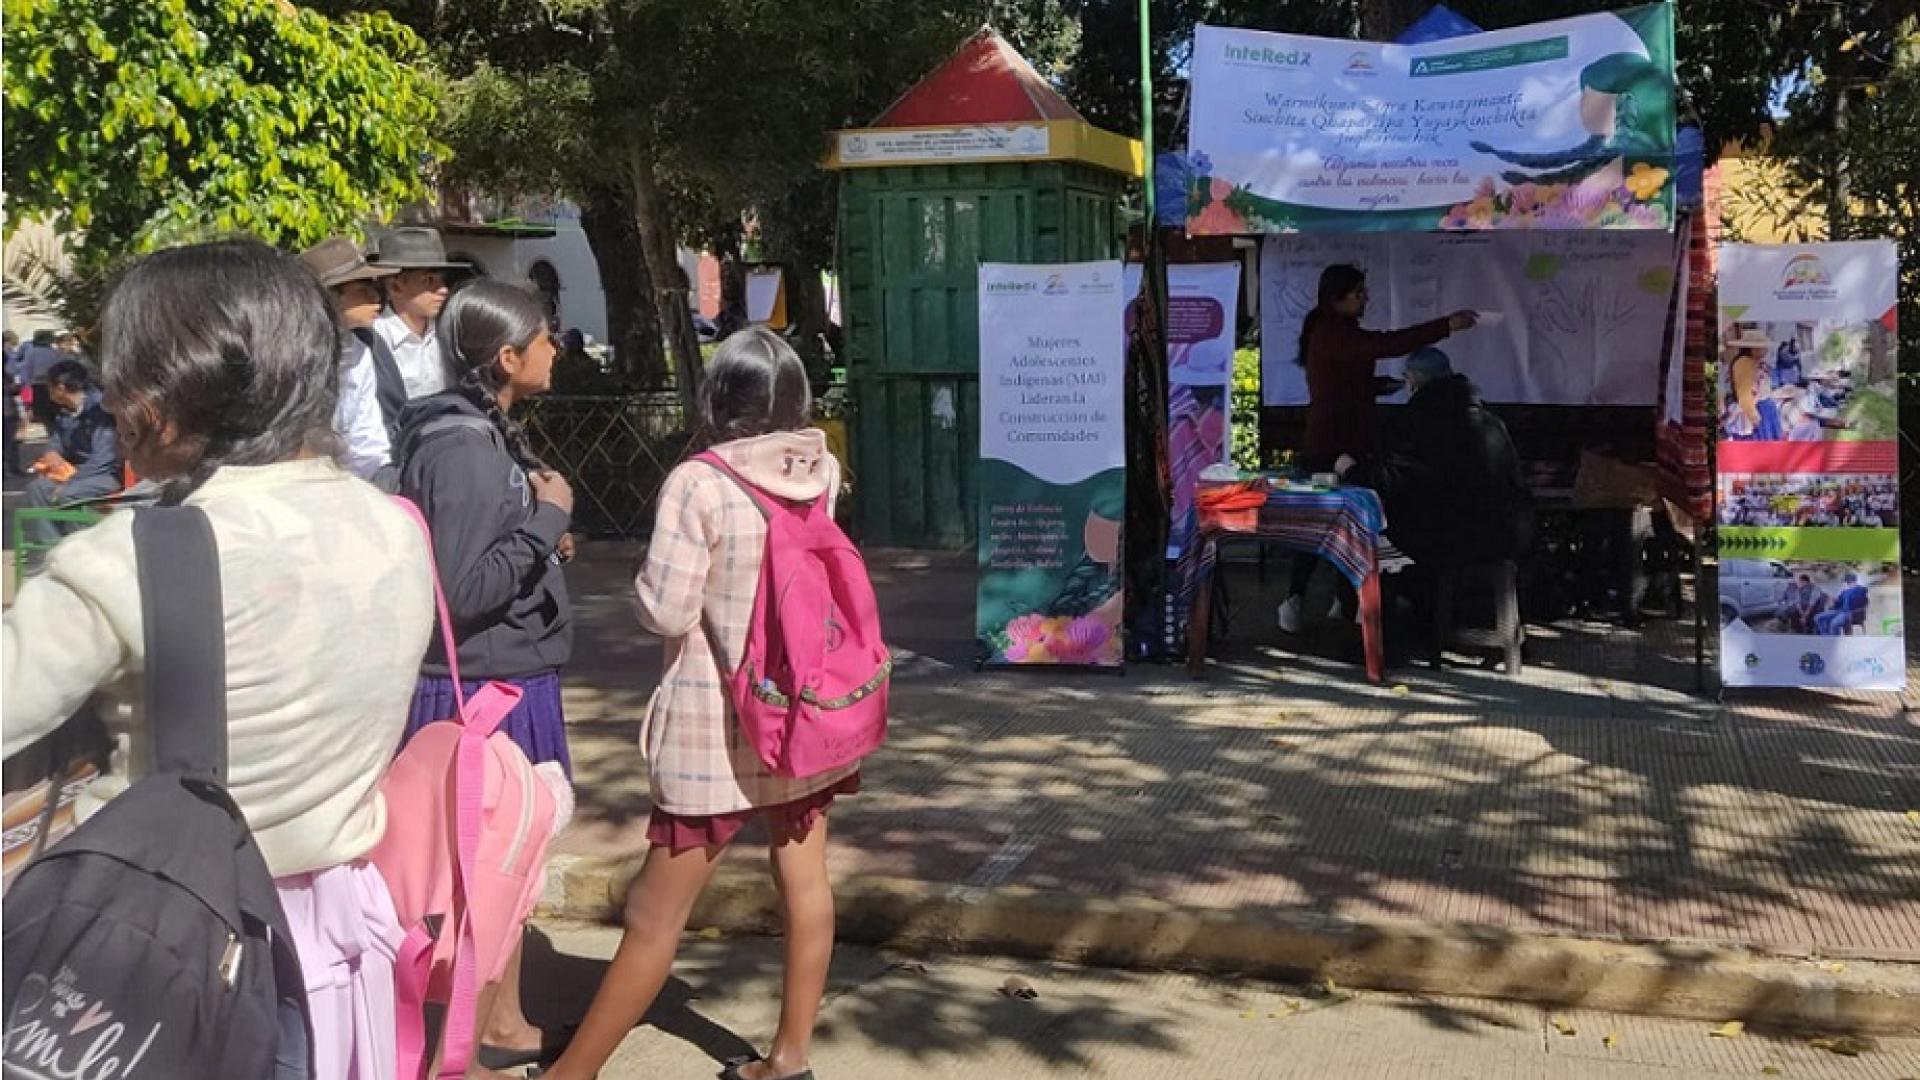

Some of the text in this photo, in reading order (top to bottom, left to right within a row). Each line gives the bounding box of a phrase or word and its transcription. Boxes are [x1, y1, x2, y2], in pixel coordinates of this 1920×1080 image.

[1224, 43, 1298, 66] InteRed
[1027, 336, 1081, 352] Mujeres
[1090, 409, 1107, 423] de
[1007, 429, 1099, 443] Comunidades
